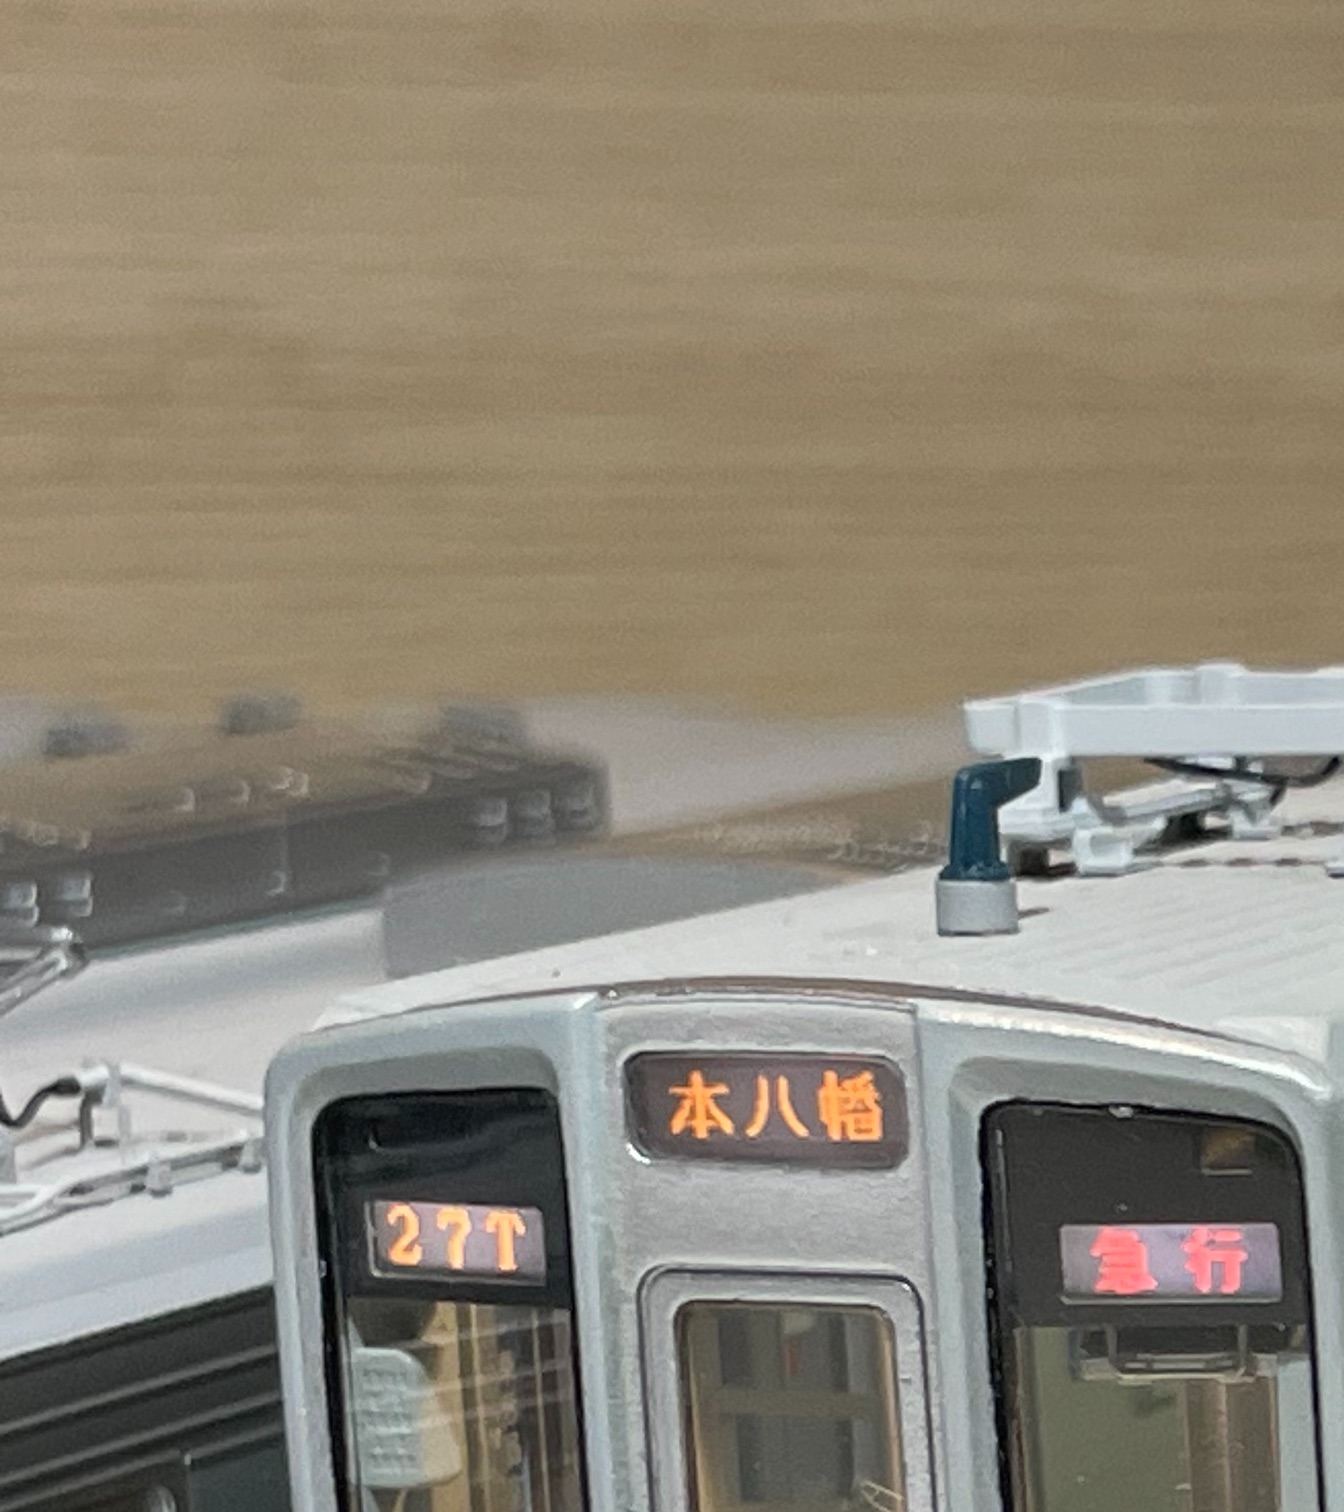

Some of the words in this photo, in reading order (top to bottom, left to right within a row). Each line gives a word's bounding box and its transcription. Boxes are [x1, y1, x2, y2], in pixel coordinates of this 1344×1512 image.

[668, 1069, 882, 1141] 本八幡
[386, 1201, 526, 1272] 27T
[1089, 1224, 1249, 1294] 急行
